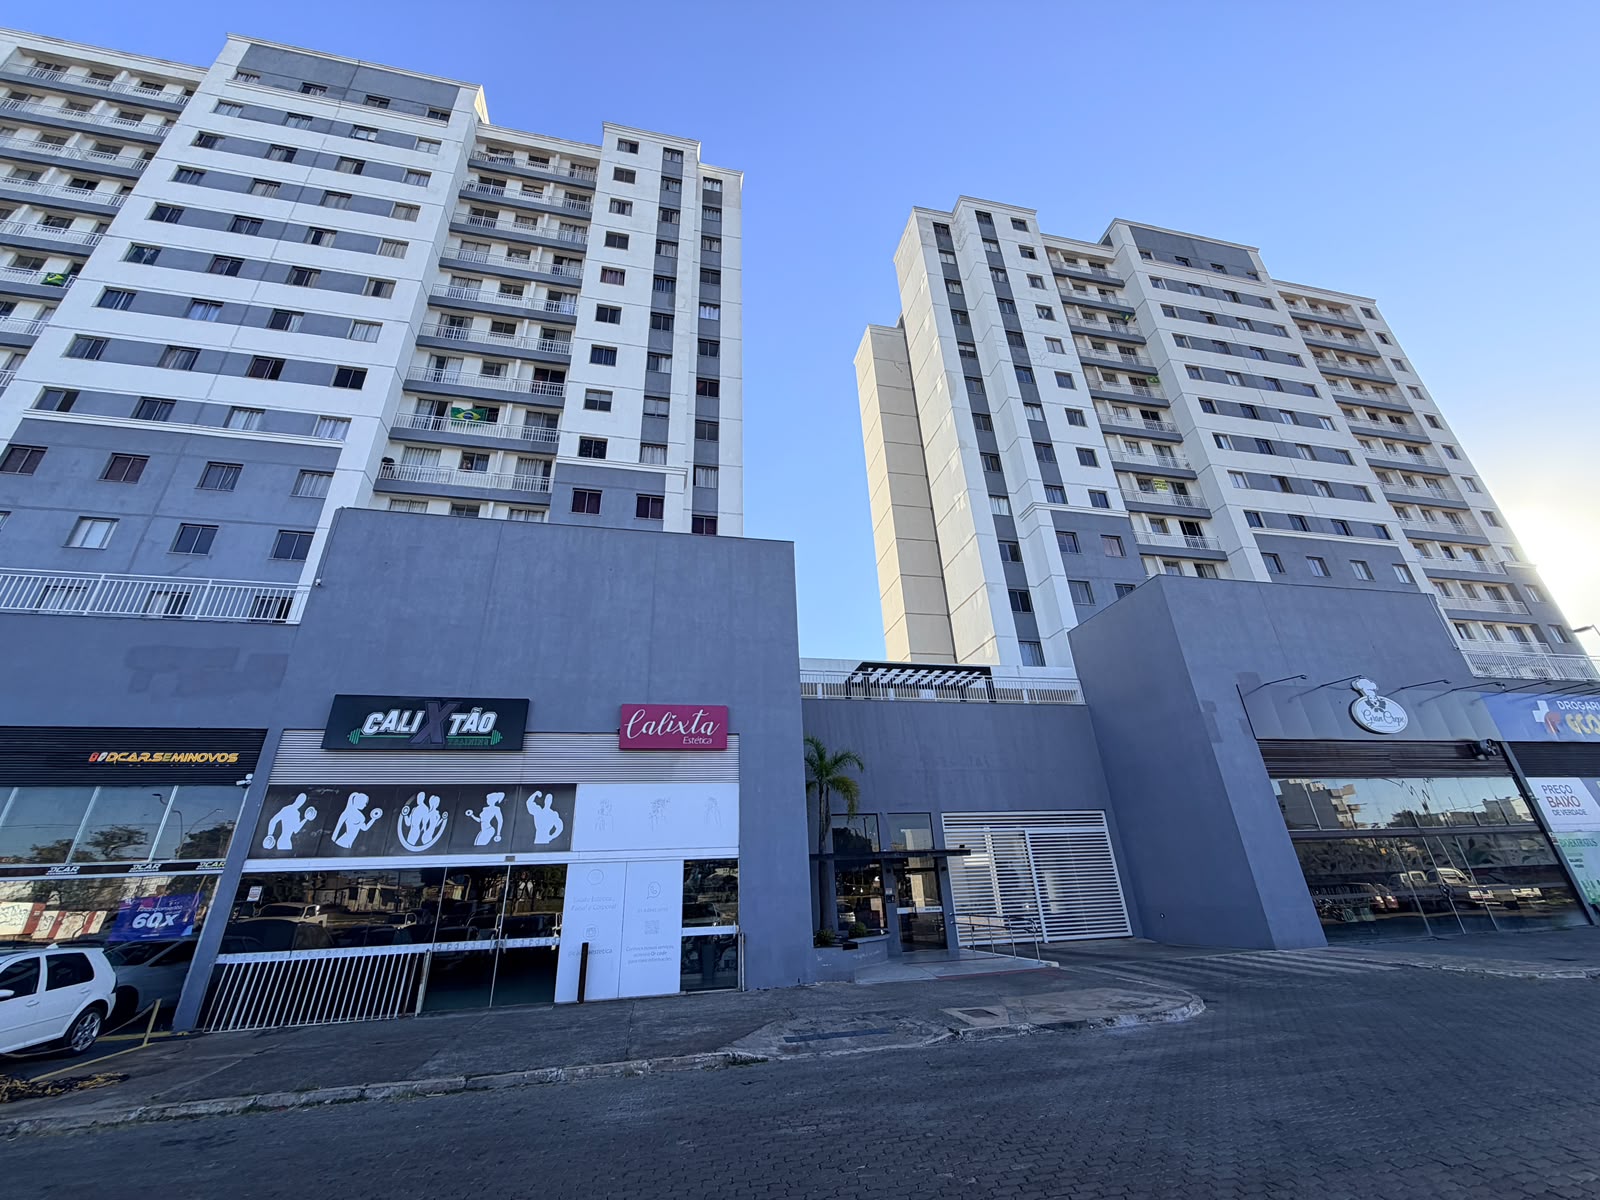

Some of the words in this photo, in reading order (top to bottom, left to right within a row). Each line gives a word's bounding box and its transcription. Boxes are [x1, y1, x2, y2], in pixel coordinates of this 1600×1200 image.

[361, 701, 498, 745] CALIXTÃO
[624, 709, 720, 739] Calixta
[1361, 709, 1383, 727] Gran
[1383, 711, 1405, 726] Crepe
[683, 735, 713, 745] Estética
[1541, 784, 1573, 796] PREÇO
[1546, 796, 1581, 808] BAIXO
